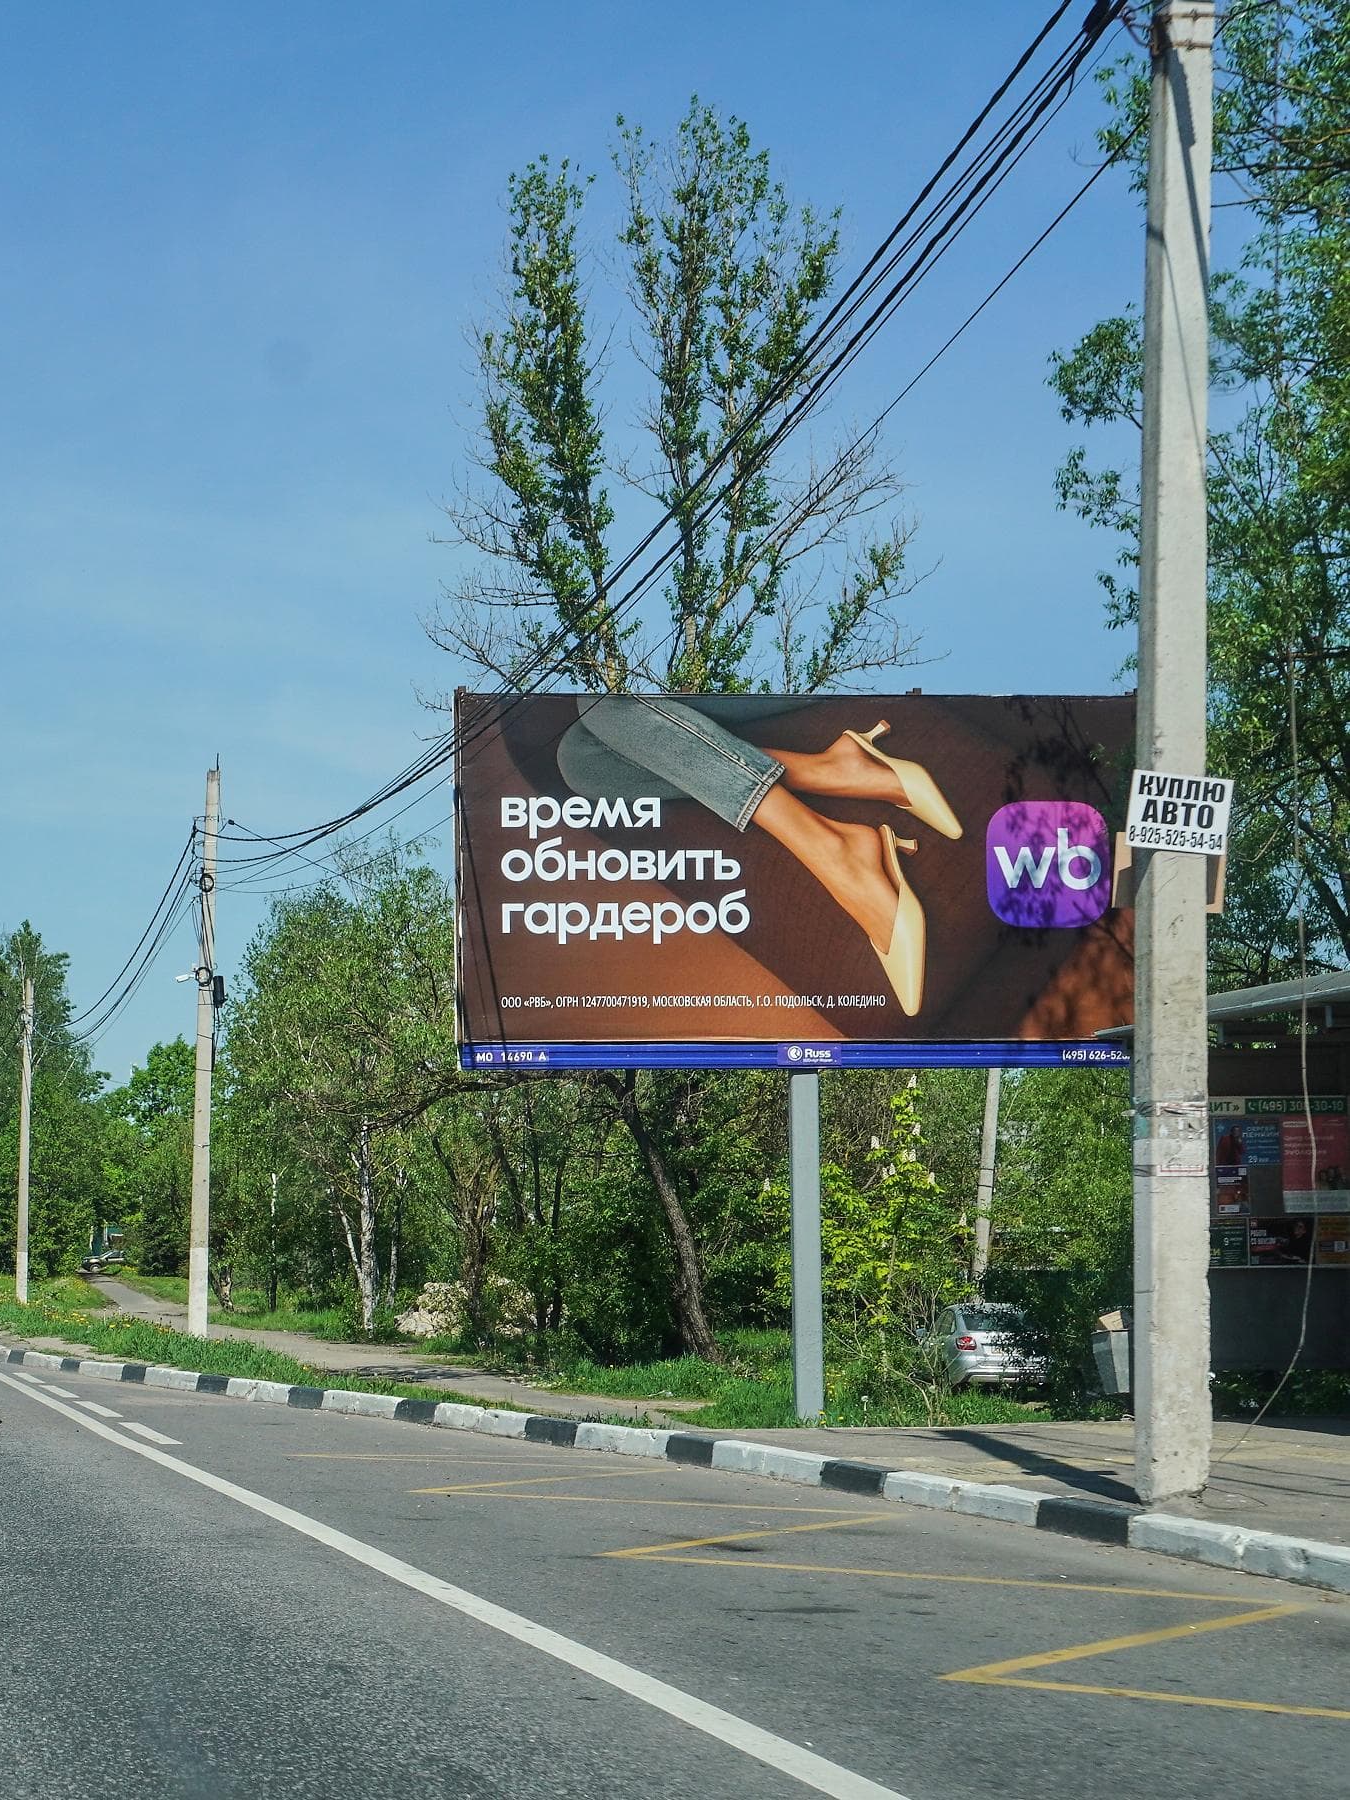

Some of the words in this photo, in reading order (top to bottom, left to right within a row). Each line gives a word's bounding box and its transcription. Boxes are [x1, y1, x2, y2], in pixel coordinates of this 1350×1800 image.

[1138, 774, 1225, 803] КУПЛЮ
[500, 796, 661, 839] время
[1141, 798, 1214, 829] АВТО
[1128, 825, 1223, 851] 8-925-525-54-54
[500, 836, 742, 882] обновить
[993, 827, 1102, 891] wb
[501, 888, 751, 945] гардероб
[501, 996, 522, 1009] ООО
[523, 996, 554, 1009] «РВБ»,
[555, 996, 579, 1008] ОГРН
[581, 995, 651, 1009] 1247700471919,
[652, 995, 712, 1008] МОСКОВСКАЯ
[713, 995, 755, 1009] ОБЛАСТЬ,
[756, 995, 773, 1008] Г.О.
[775, 995, 825, 1009] ПОДОЛЬСК,
[826, 995, 836, 1008] Д.
[837, 994, 886, 1008] КОЛЕДИНО
[476, 1052, 493, 1062] МО
[500, 1051, 533, 1062] 14690
[804, 1048, 832, 1058] Russ
[1062, 1049, 1087, 1061] (495)
[1258, 1099, 1287, 1113] (495)
